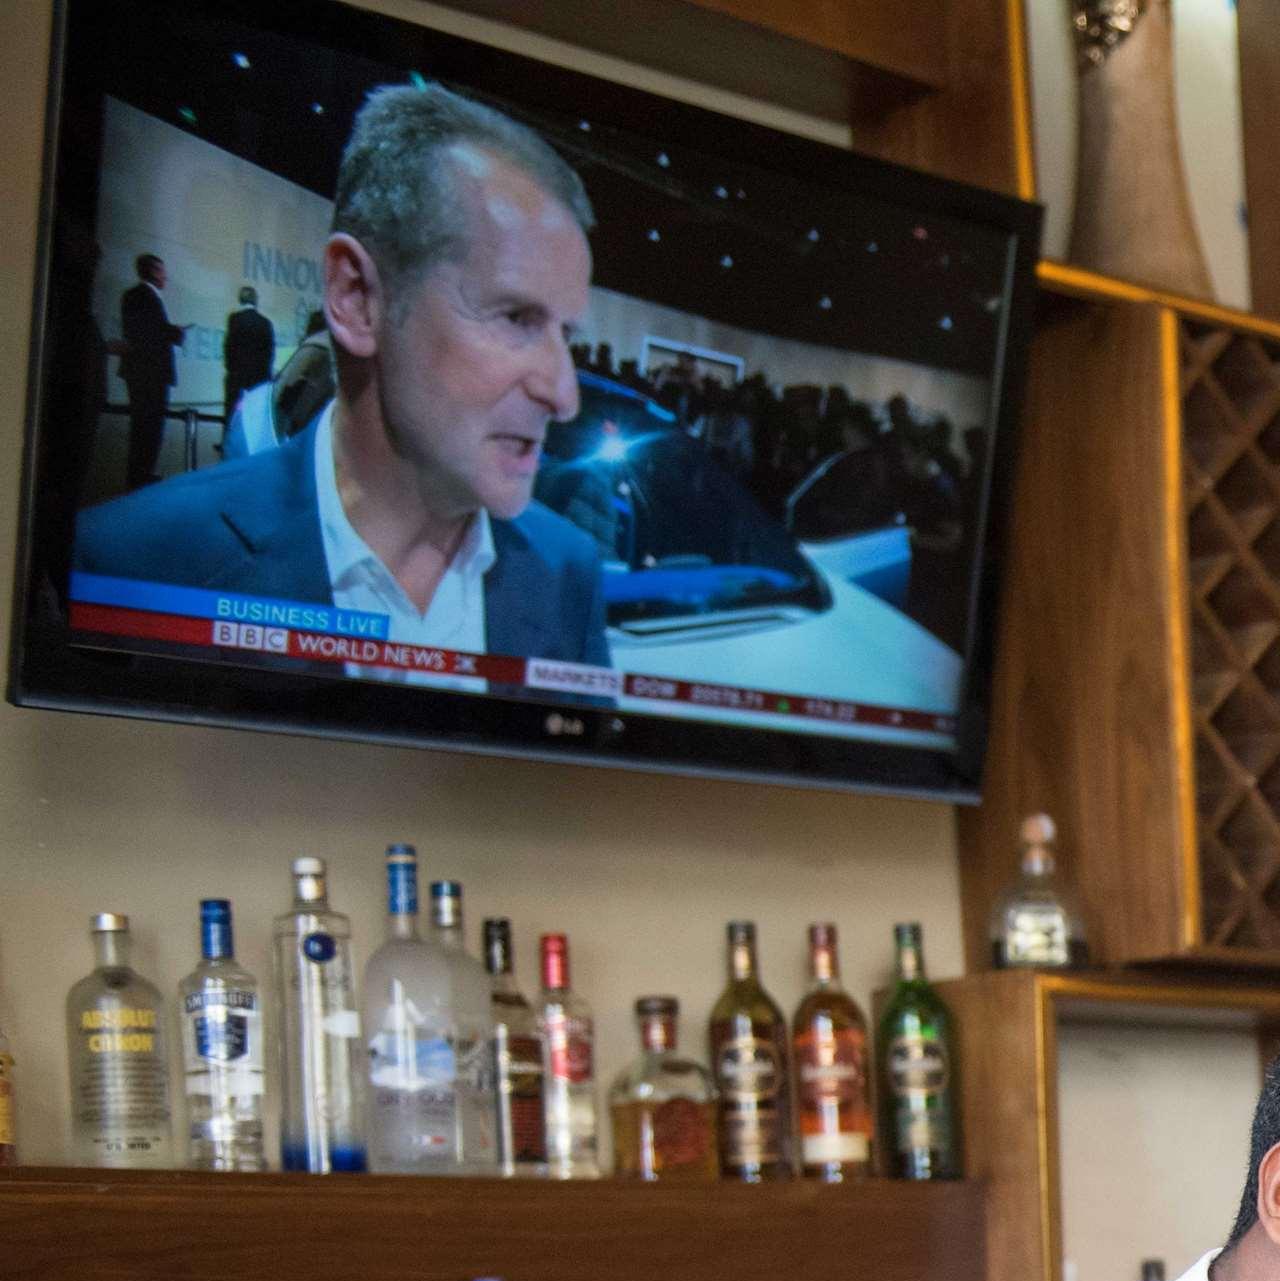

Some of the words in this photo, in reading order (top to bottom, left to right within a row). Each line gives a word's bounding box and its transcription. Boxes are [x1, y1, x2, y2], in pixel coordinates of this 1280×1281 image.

[216, 597, 329, 630] BUSINESS
[336, 613, 382, 637] LIVE
[216, 623, 287, 651] BBC
[296, 632, 378, 662] WORLD
[384, 646, 446, 671] NEWS
[534, 665, 618, 690] MARKETS
